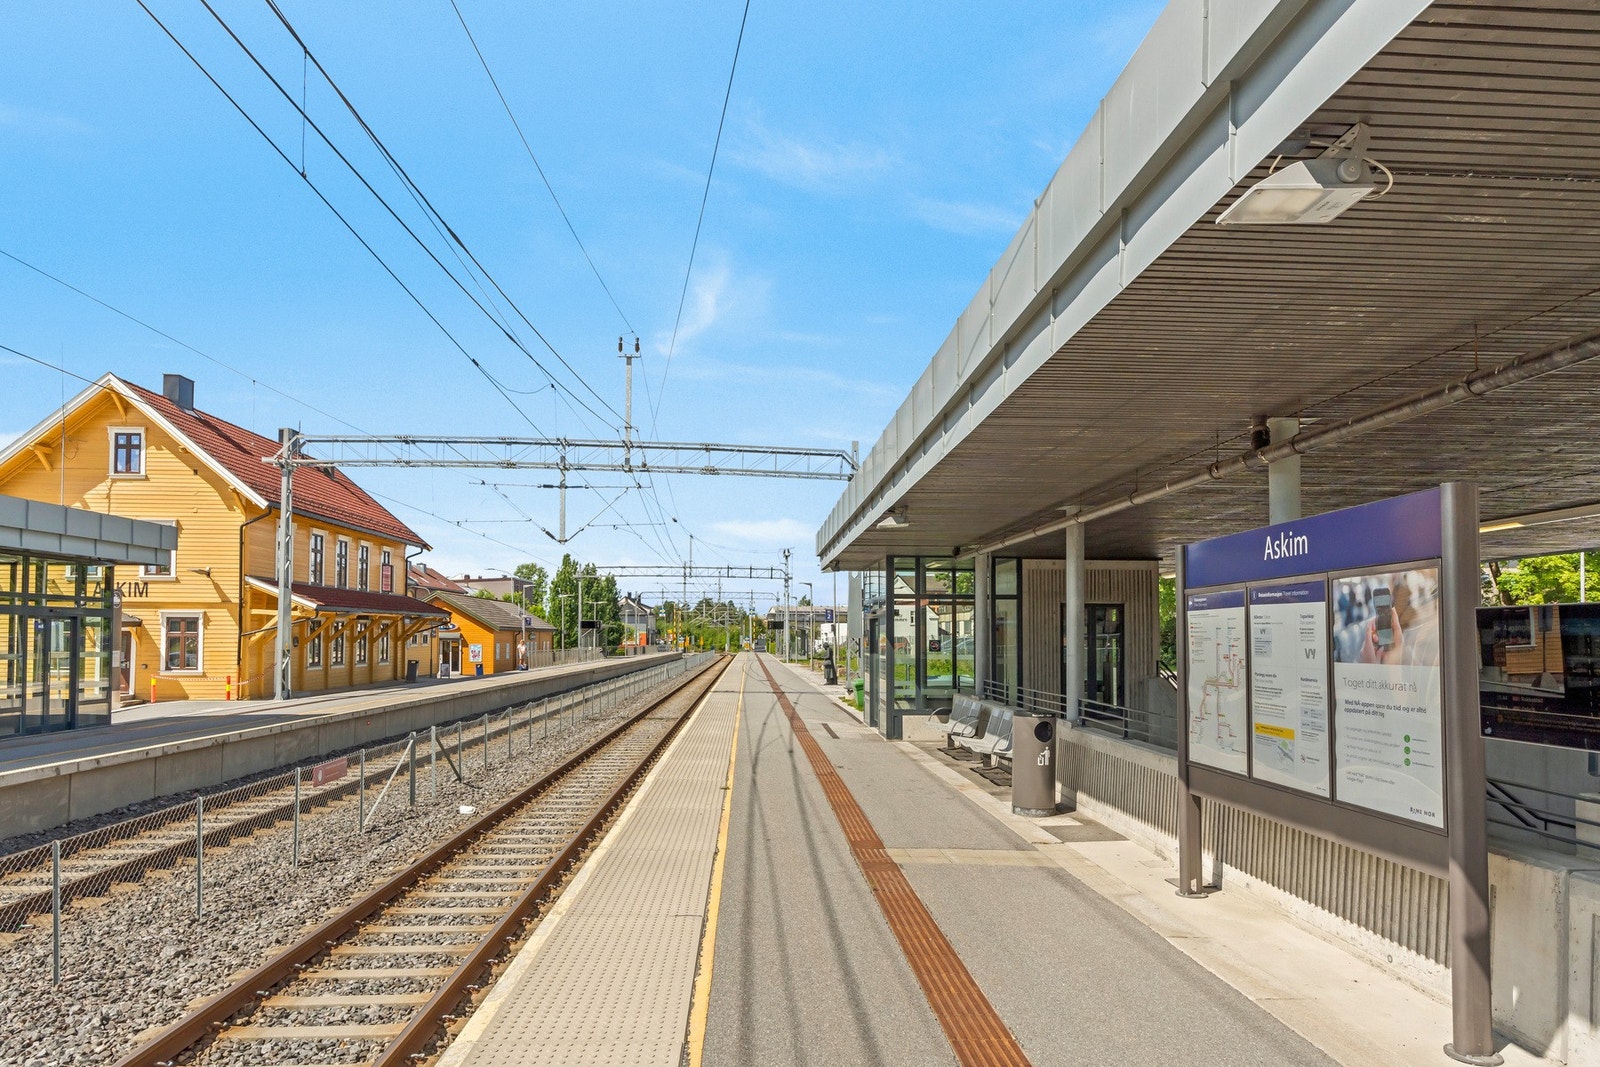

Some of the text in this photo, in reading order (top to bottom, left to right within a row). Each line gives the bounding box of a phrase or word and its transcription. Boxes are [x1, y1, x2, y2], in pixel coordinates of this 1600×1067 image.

[1264, 531, 1308, 560] Askim
[93, 581, 149, 598] AKIM
[1342, 677, 1364, 689] Toget
[1378, 680, 1407, 692] akkurat
[1408, 682, 1417, 692] nå
